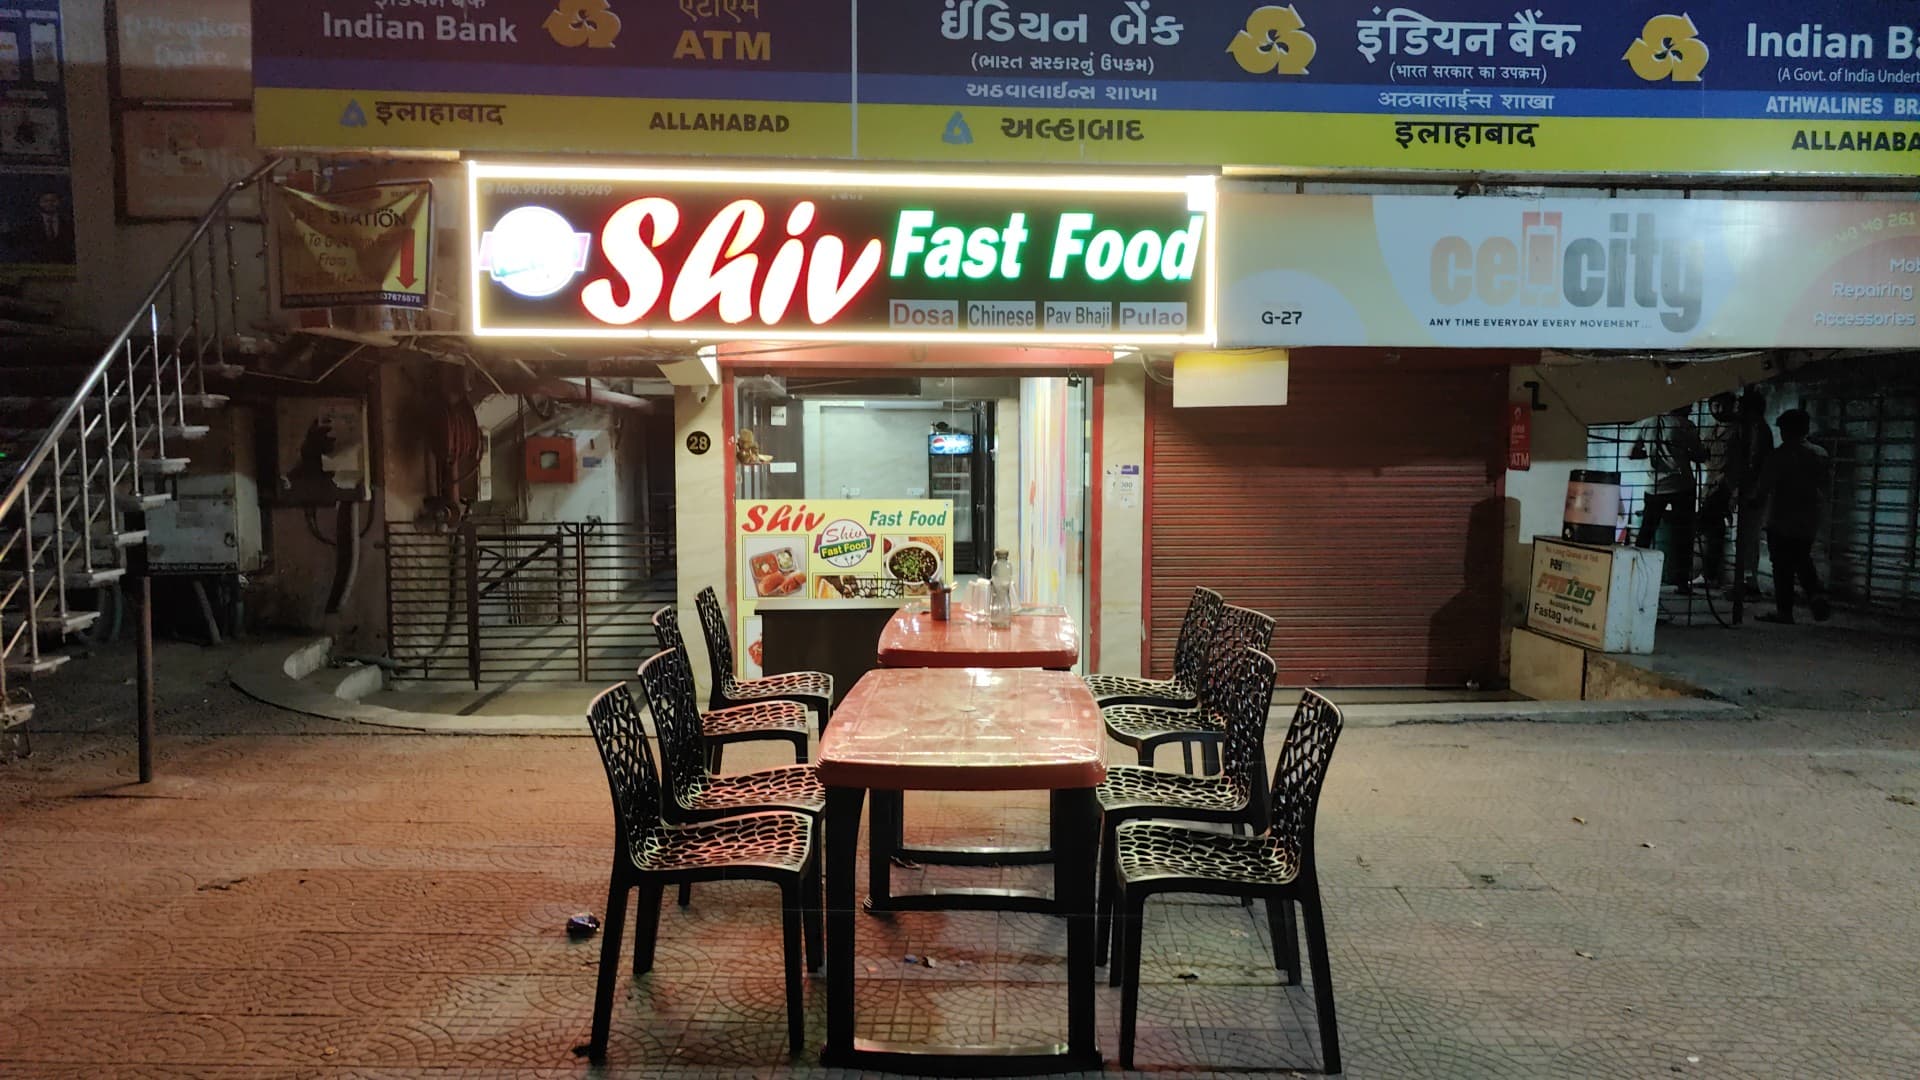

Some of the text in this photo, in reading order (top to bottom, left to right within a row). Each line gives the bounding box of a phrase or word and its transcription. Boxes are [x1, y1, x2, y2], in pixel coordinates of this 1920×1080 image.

[323, 12, 518, 43] Indian Bank
[1110, 0, 1184, 46] બેંક
[672, 29, 771, 61] ATM
[1357, 6, 1582, 64] इंडियन बैंक
[1747, 22, 1873, 59] Indian
[970, 52, 1023, 71] (ભારત
[1029, 51, 1095, 76] સરકારનું
[1389, 62, 1548, 84] (भारत सरकार का उपक्रम)
[1778, 67, 1791, 82] (A
[1794, 67, 1826, 81] Govt.
[1829, 68, 1842, 82] of
[1845, 69, 1875, 82] India
[1105, 86, 1157, 101] શાખા
[1377, 89, 1555, 110] अठवालाईन्स शाखा
[375, 101, 507, 126] इलाहाबाद
[1766, 95, 1884, 115] ATHWALINES
[649, 112, 790, 133] ALLAHABAD
[1000, 117, 1145, 142] અલ્હાબાદ
[1394, 121, 1540, 149] इलाहाबाद
[581, 196, 1205, 326] Shiv Fast Food
[1832, 281, 1914, 301] Repairing
[894, 303, 1185, 328] Dosa Chinese Pav Bhaji Pulao
[1261, 311, 1303, 325] G-27
[1429, 318, 1451, 327] ANY
[1455, 318, 1481, 327] TIME
[1484, 319, 1538, 327] EVERYDAY
[1542, 319, 1577, 328] EVERY
[1813, 310, 1917, 328] Accessories
[689, 435, 708, 451] 28
[1511, 452, 1530, 467] ATM
[741, 504, 947, 533] Shiv Fast Food
[825, 523, 863, 544] Shiv
[821, 541, 868, 558] Fast Food
